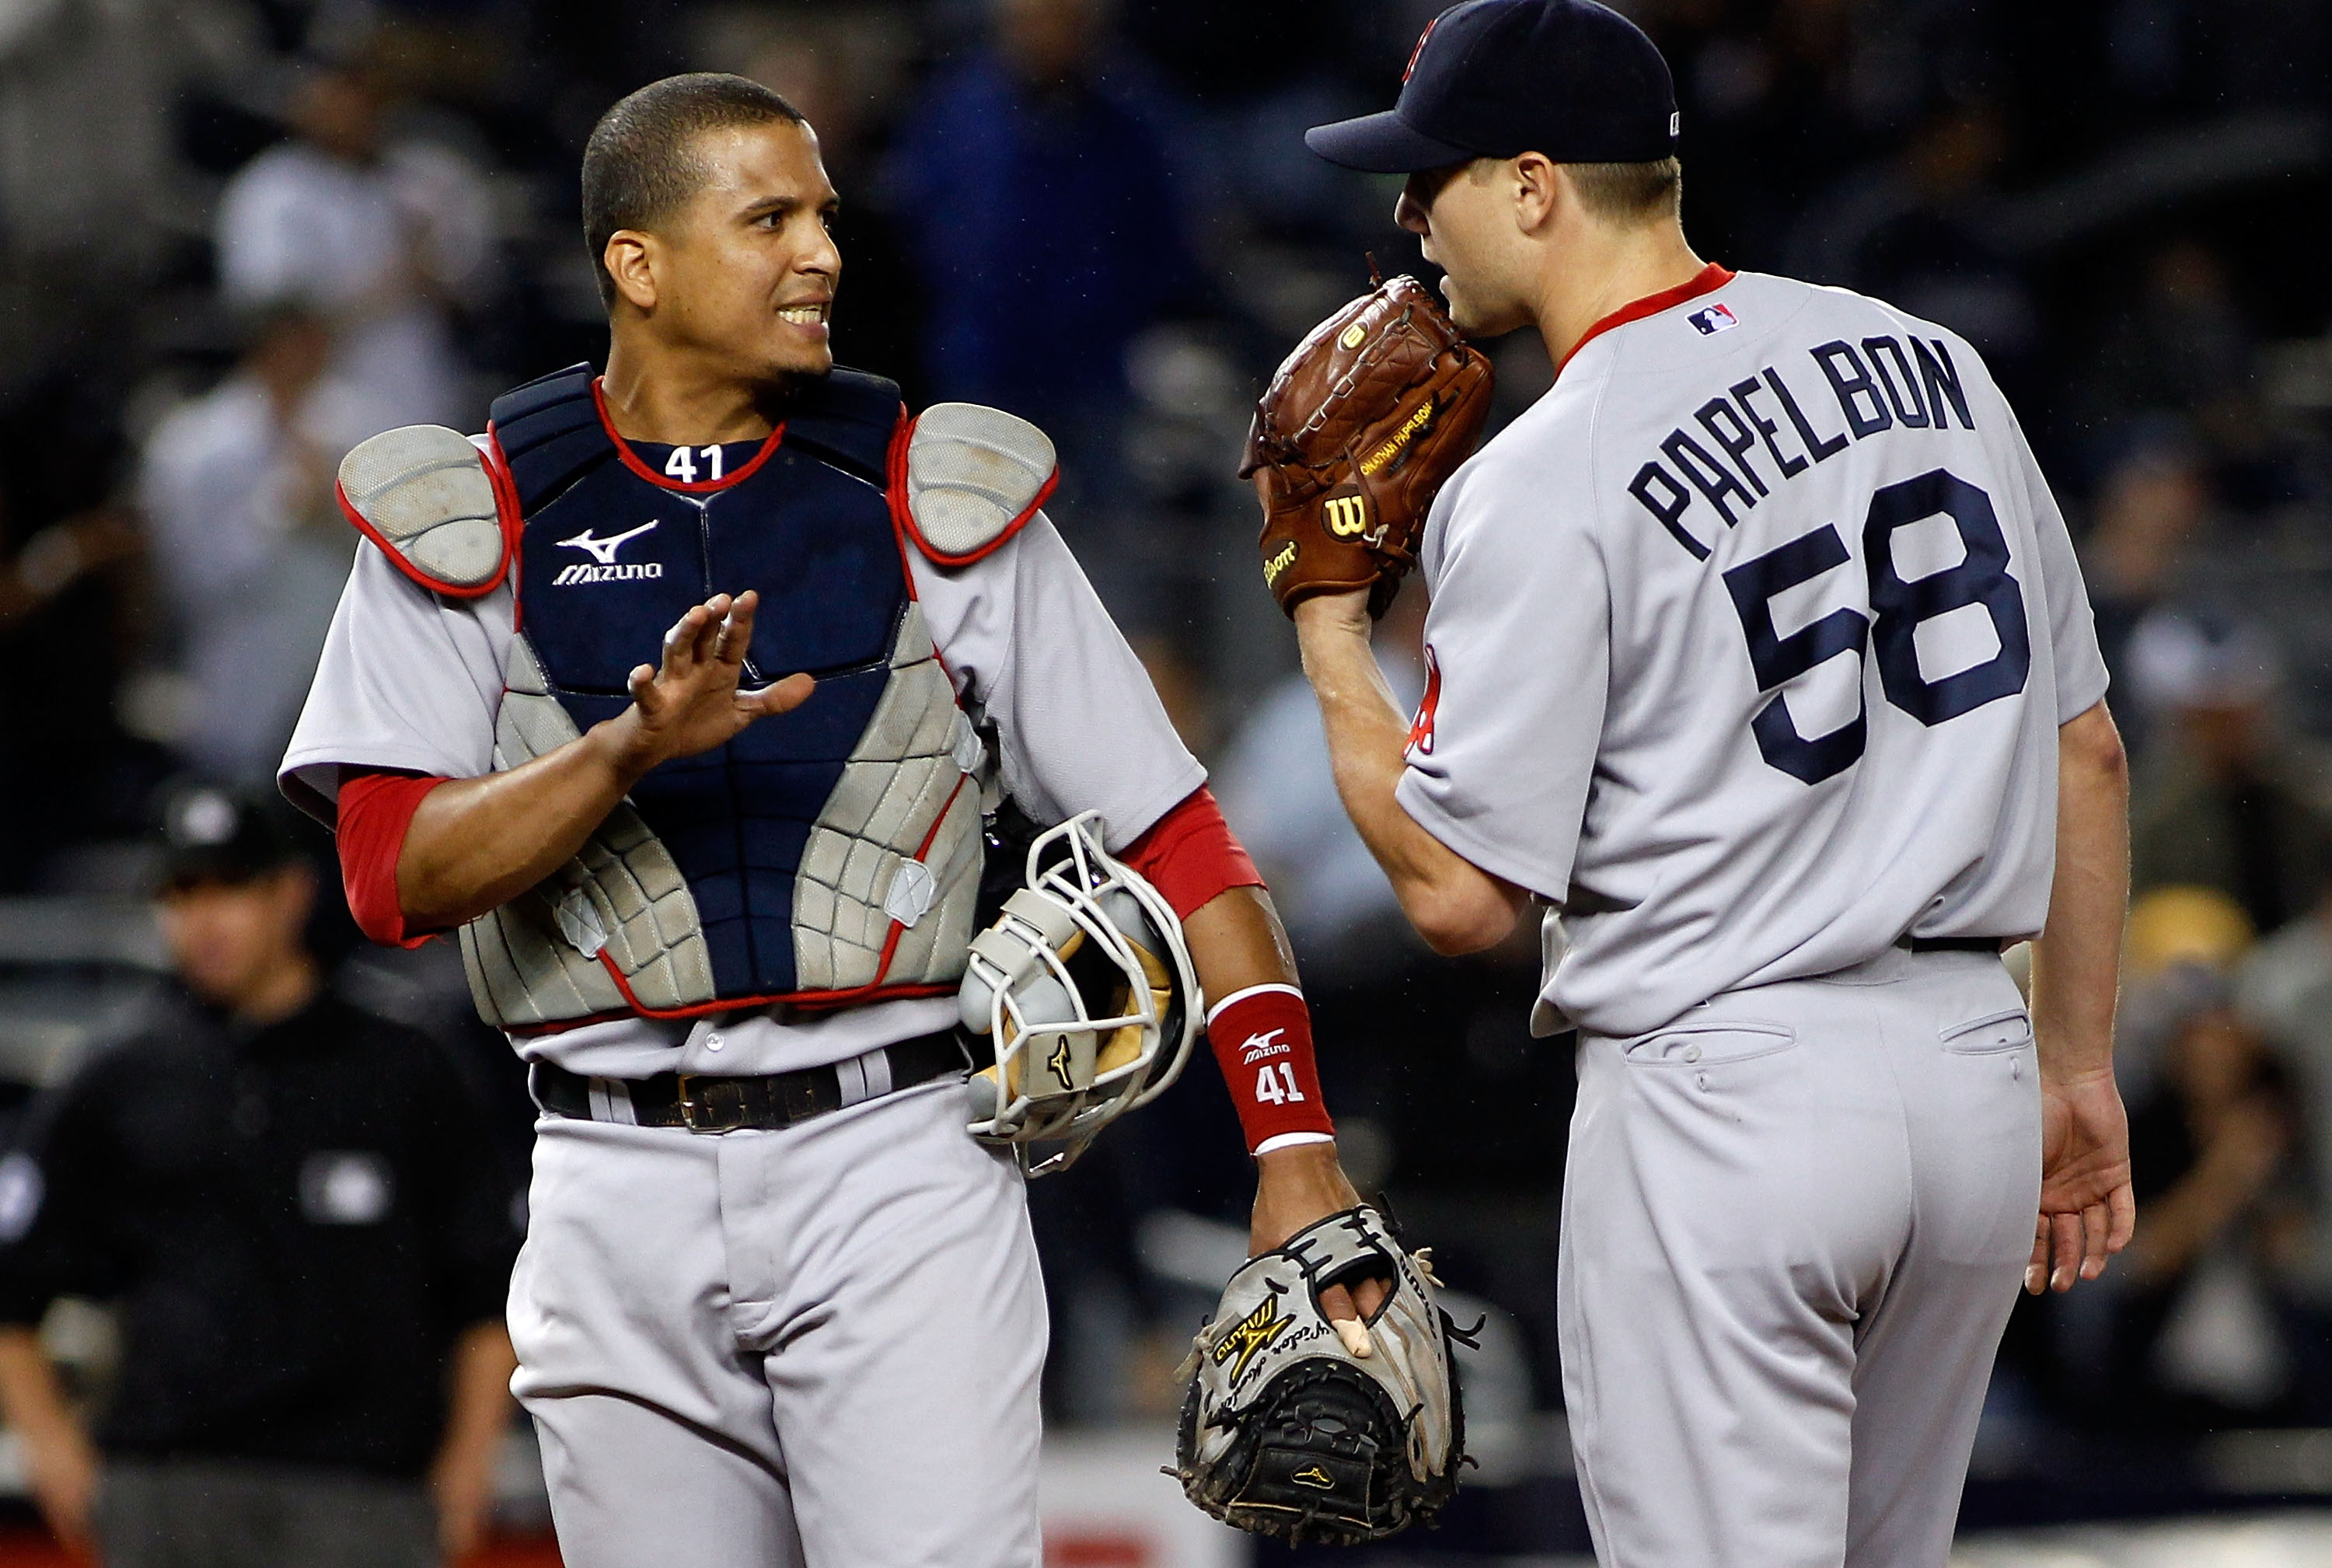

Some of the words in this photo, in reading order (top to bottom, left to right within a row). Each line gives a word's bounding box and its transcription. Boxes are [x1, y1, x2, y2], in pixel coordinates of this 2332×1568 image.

[665, 444, 722, 484] 41
[1360, 441, 1398, 476] ONATHAN
[1627, 335, 1976, 563] PAPELBON
[1722, 467, 2031, 787] 58
[1255, 1062, 1305, 1105] 41
